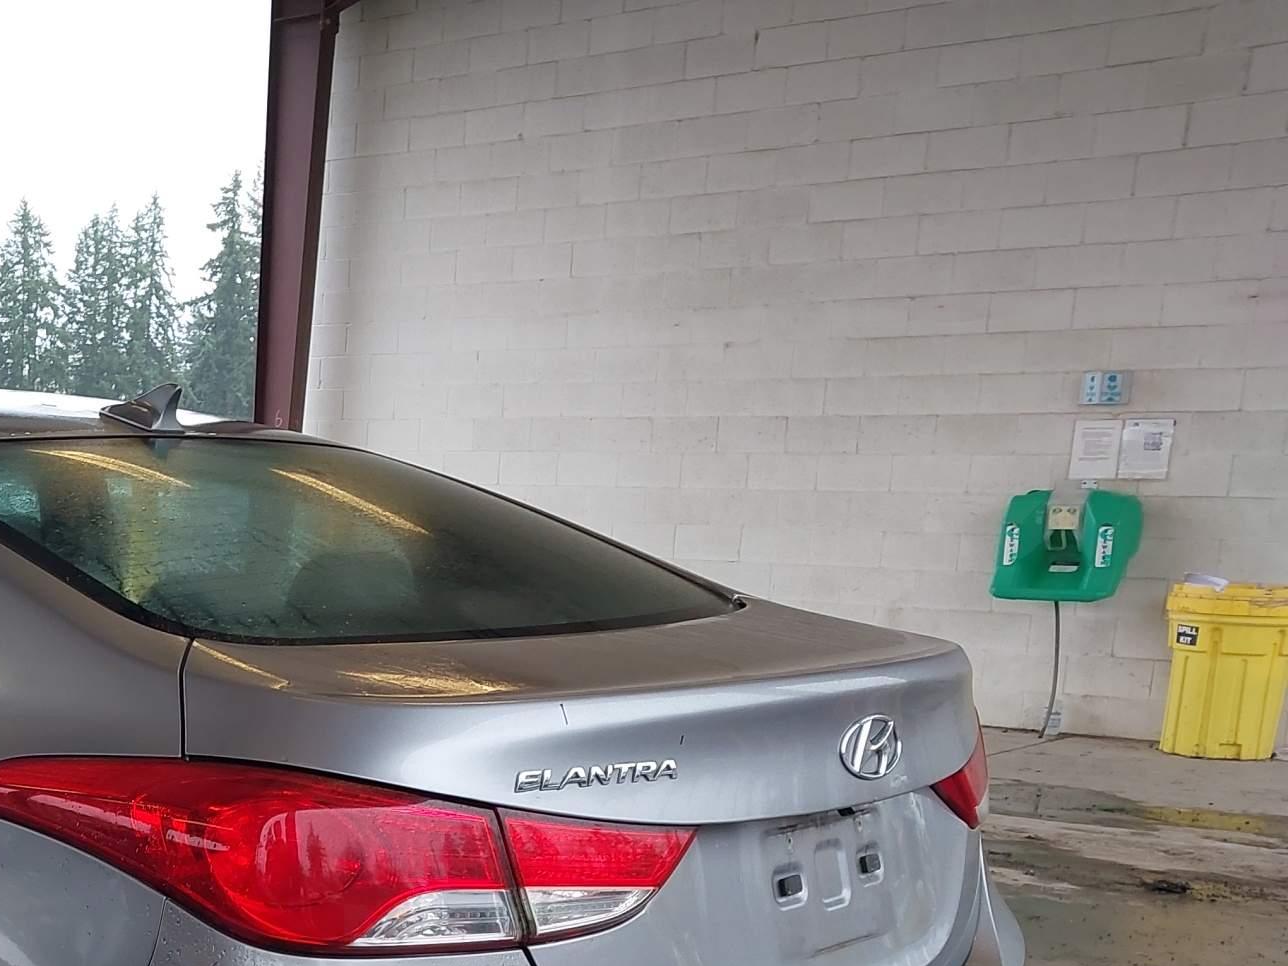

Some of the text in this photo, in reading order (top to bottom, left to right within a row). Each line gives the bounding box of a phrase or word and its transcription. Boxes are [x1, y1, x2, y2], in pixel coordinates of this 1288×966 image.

[1178, 626, 1197, 635] SPILL
[1179, 636, 1192, 644] KIT
[514, 759, 678, 793] ELANTRA
